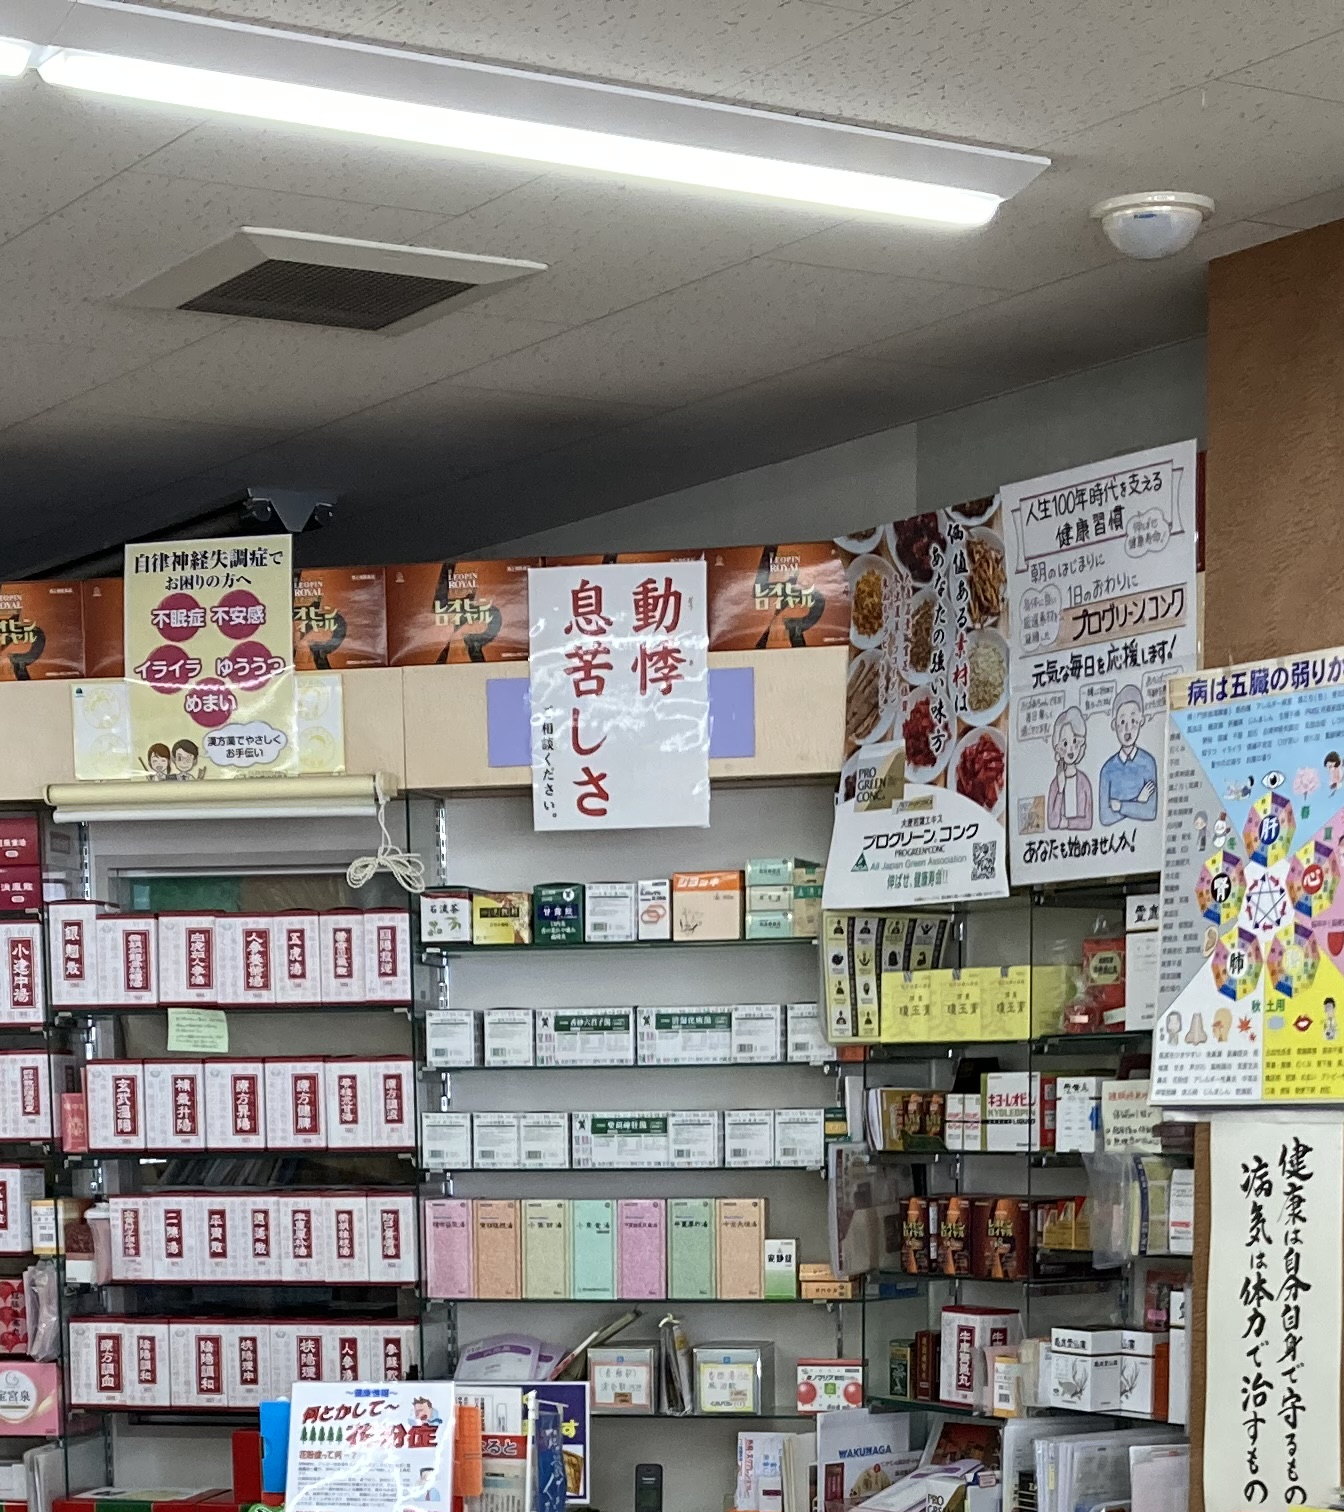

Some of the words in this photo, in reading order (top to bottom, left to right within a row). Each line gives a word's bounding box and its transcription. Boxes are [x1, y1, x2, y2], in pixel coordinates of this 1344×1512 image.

[1056, 506, 1126, 549] 健康習慣
[134, 546, 284, 572] 自律神経失調症で
[1030, 554, 1106, 582] 朝のはじまりに
[165, 573, 252, 591] お困りの方へ
[152, 603, 207, 628] 不眠症
[211, 602, 266, 627] 不安感
[632, 578, 684, 695] 動悸
[134, 655, 203, 682] イライラ
[215, 654, 286, 679] ゆううつ
[185, 691, 238, 715] めまい
[563, 578, 615, 820] 息苦しさ
[206, 733, 282, 748] 漢方薬でやさしく
[225, 745, 265, 760] お手伝い
[857, 777, 887, 791] GREEN
[858, 767, 877, 781] PRO
[1303, 870, 1323, 887] 心
[1239, 1155, 1274, 1505] 病気は体力で治すもの
[1276, 1136, 1314, 1505] 健康は自分自身で守るもの
[839, 1444, 891, 1459] WAKUNAGA
